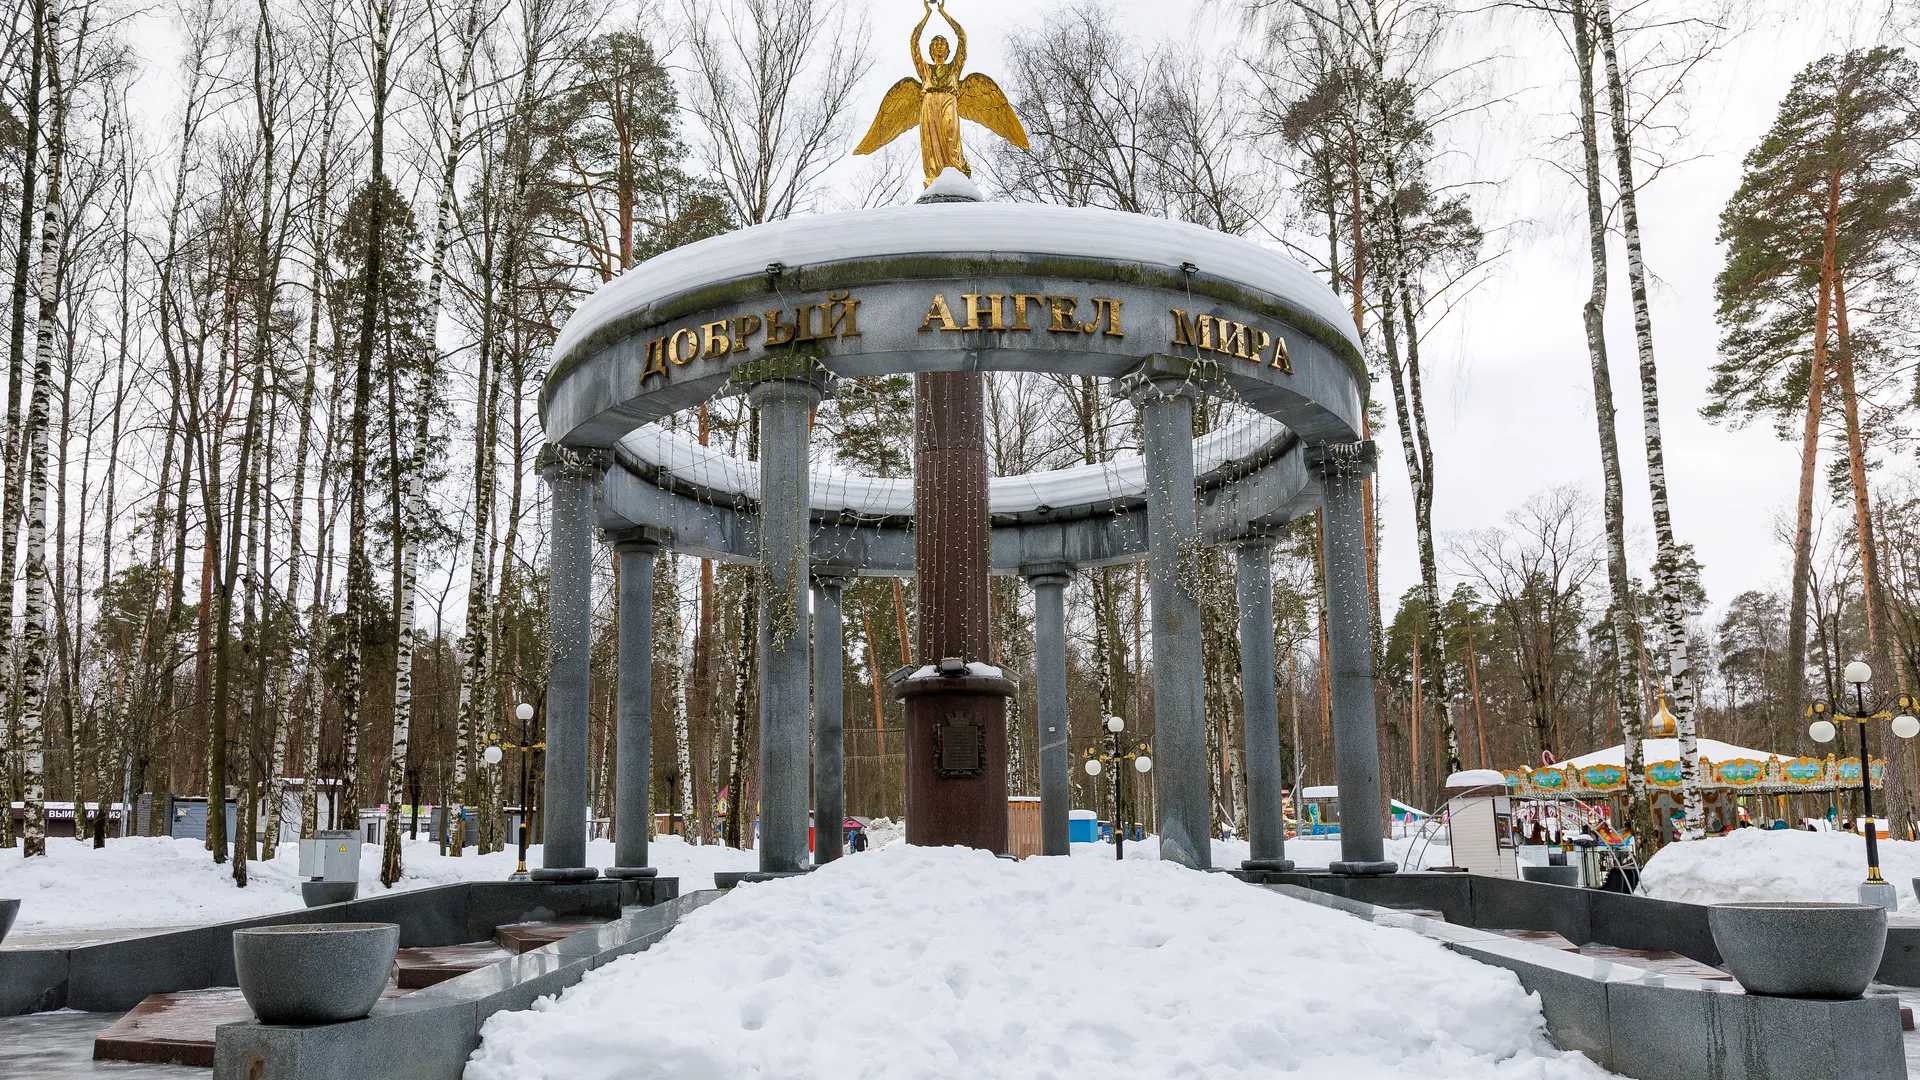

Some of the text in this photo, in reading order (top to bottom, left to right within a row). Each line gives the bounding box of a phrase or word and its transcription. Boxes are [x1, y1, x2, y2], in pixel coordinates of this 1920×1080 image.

[640, 290, 1295, 387] ДОБРЫЙ АНГЕЛ МИРА
